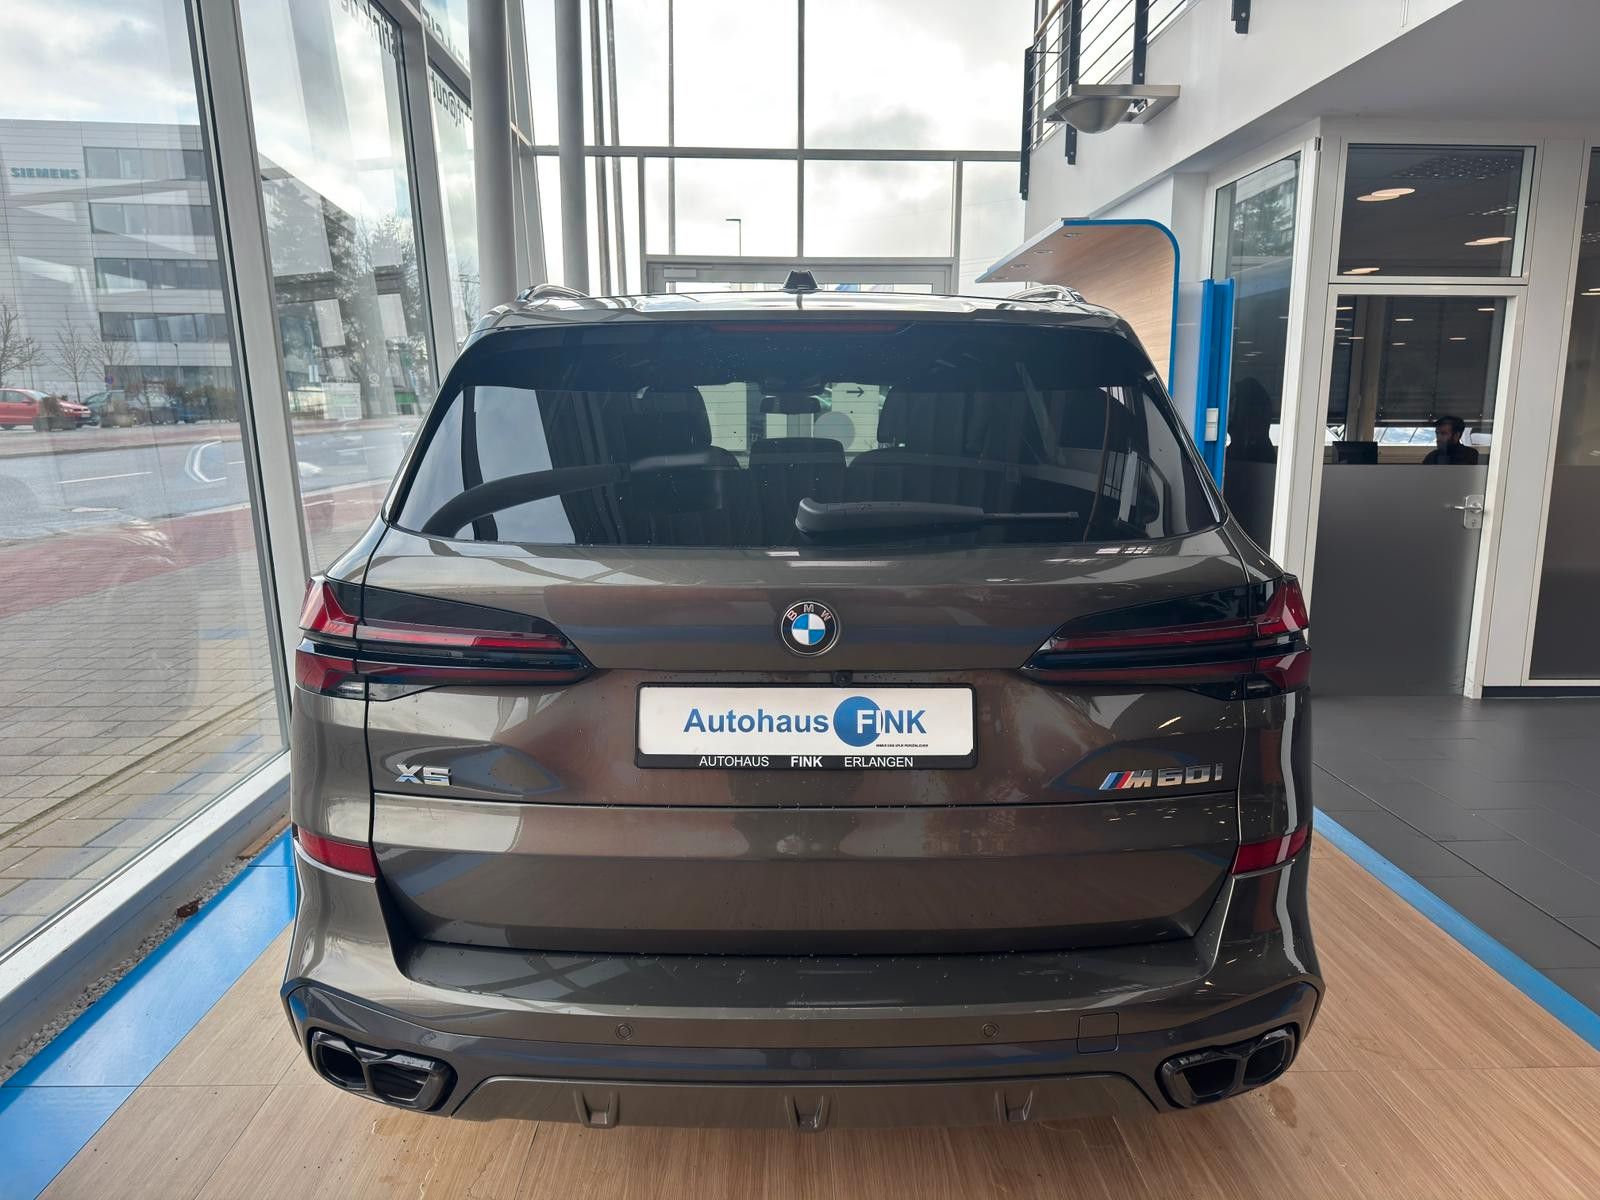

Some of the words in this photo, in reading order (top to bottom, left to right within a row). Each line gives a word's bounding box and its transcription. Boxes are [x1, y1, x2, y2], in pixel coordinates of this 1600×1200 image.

[10, 167, 80, 179] SIEMENS
[787, 603, 831, 621] BMW
[684, 708, 829, 733] Autohaus
[857, 709, 927, 734] FINK
[699, 755, 770, 768] AUTOHAUS
[790, 755, 823, 768] FINK
[844, 756, 914, 768] ERLANGEN
[395, 764, 450, 786] X5
